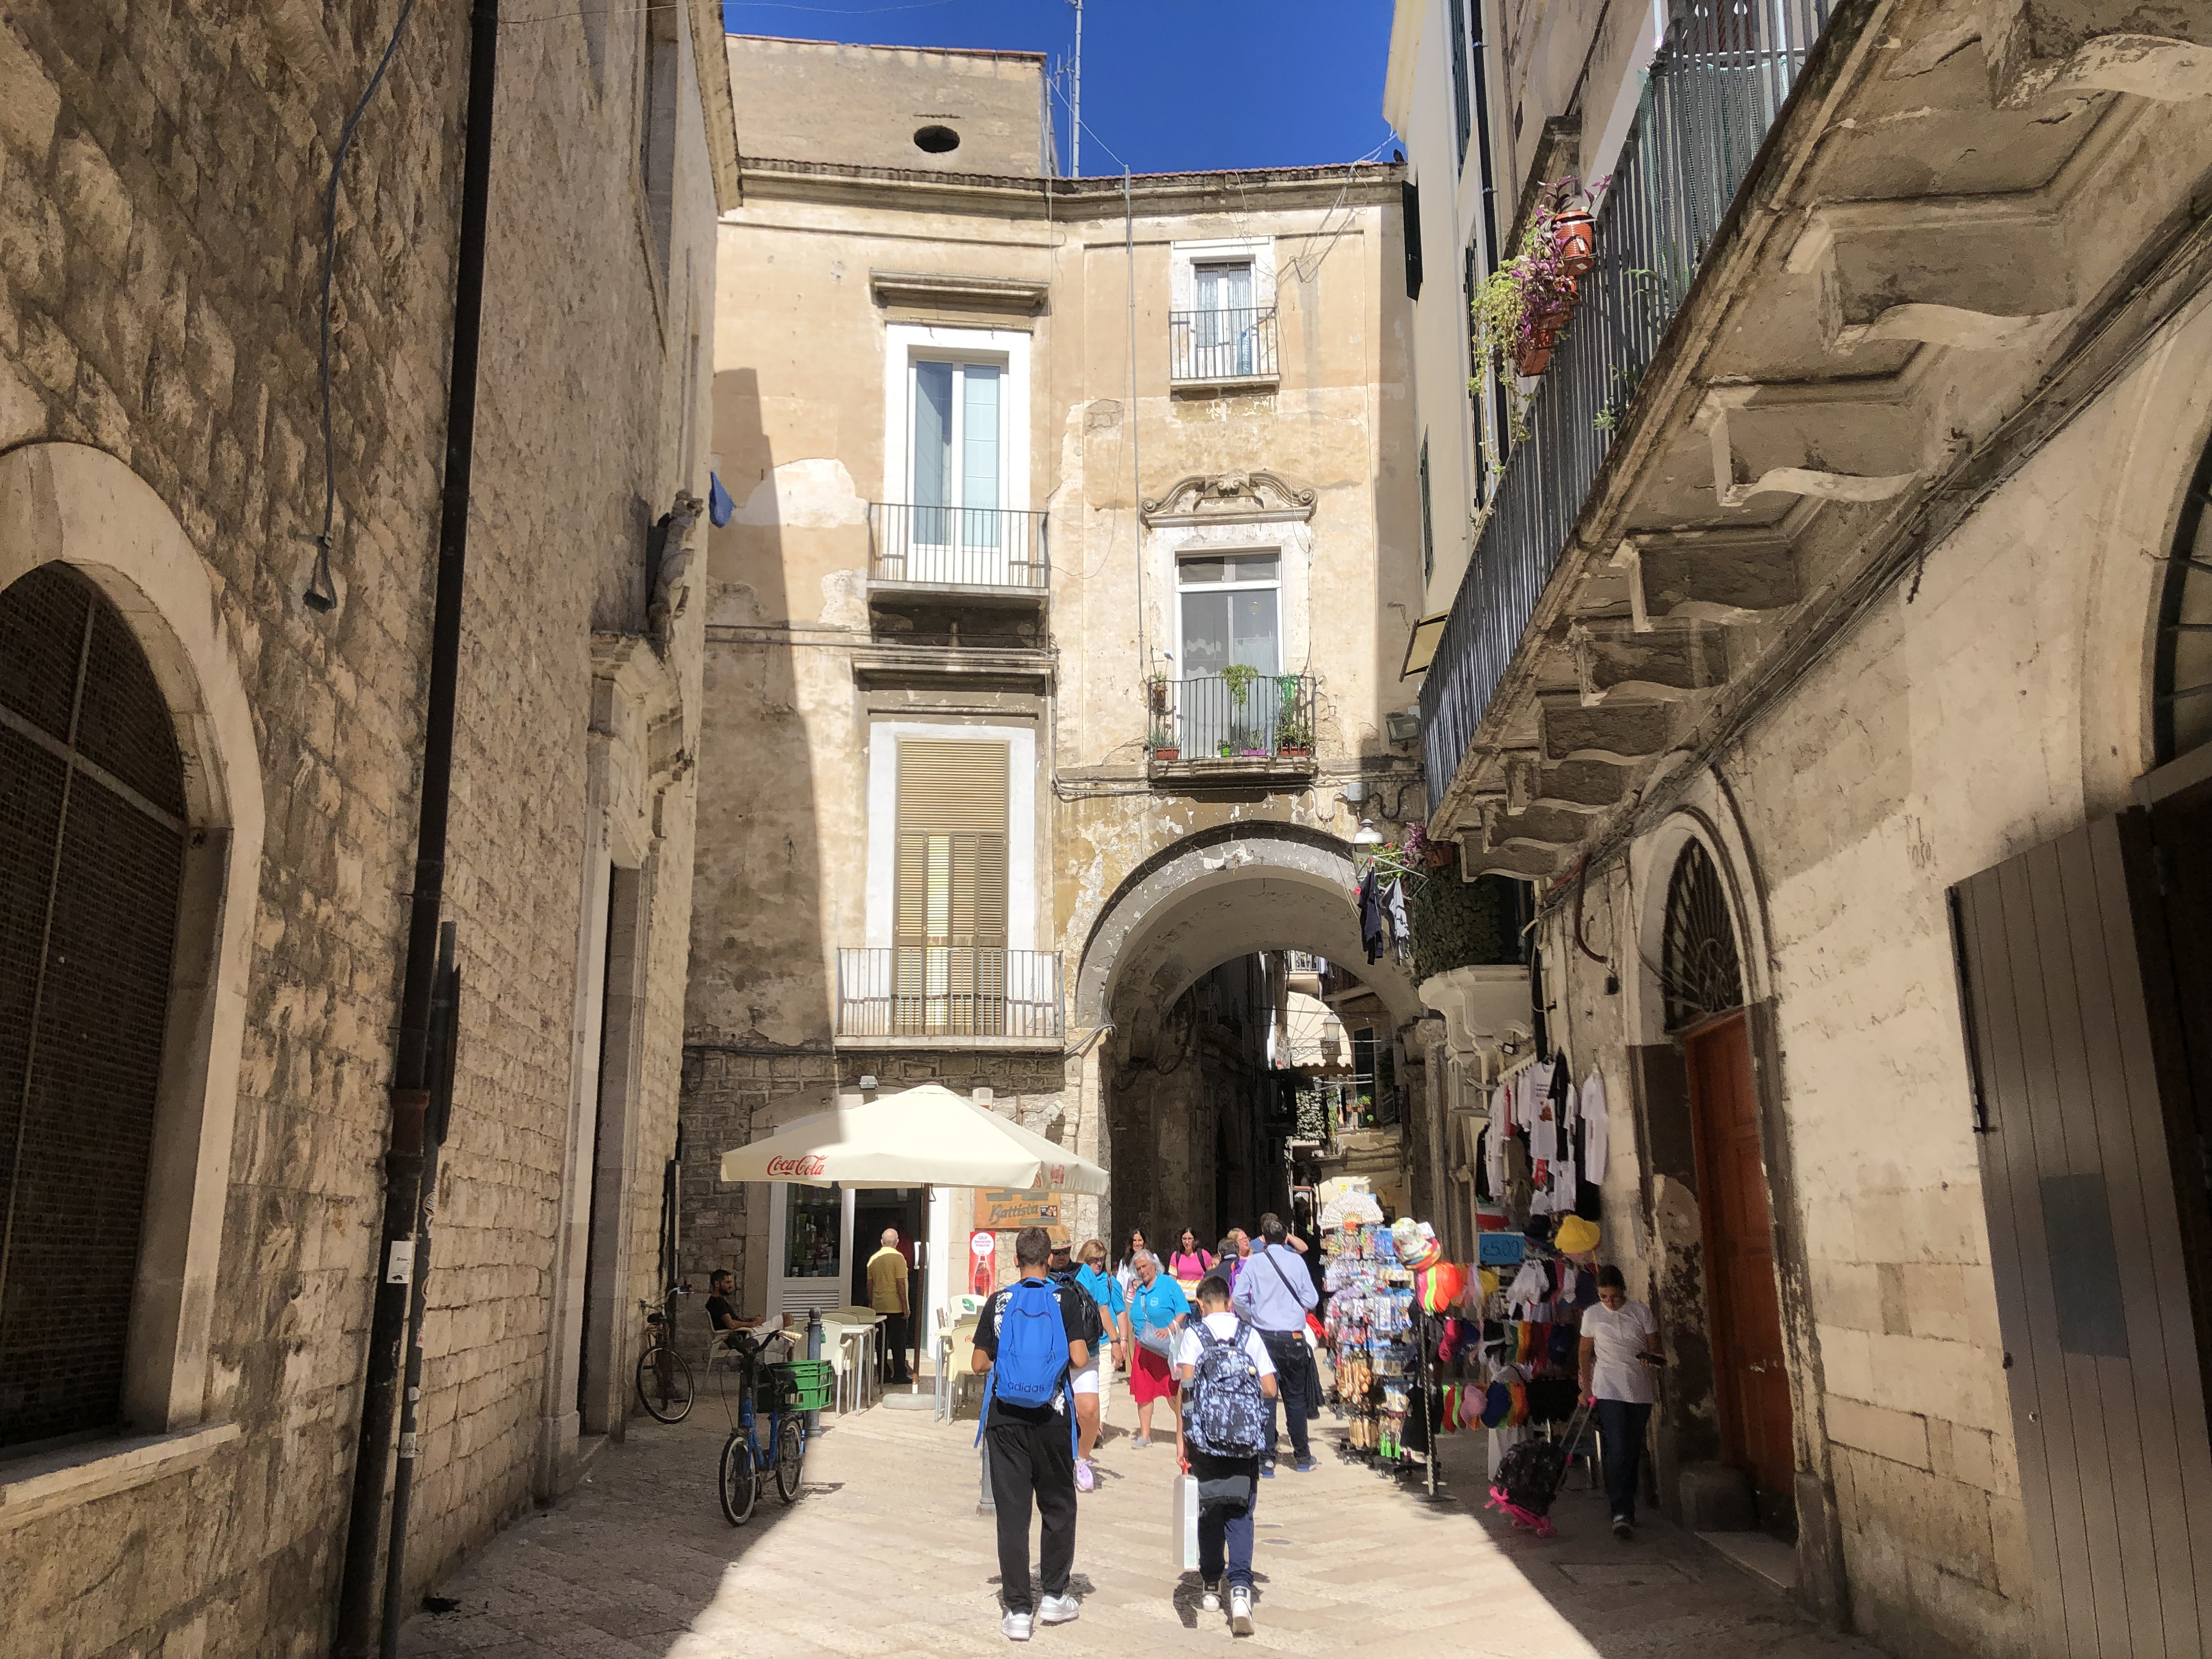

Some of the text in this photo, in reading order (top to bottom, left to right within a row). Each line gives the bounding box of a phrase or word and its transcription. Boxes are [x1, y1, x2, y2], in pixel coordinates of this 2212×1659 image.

[767, 1155, 828, 1176] Coca-Cola
[989, 1203, 1039, 1225] Battista
[1008, 1381, 1044, 1392] adidas
